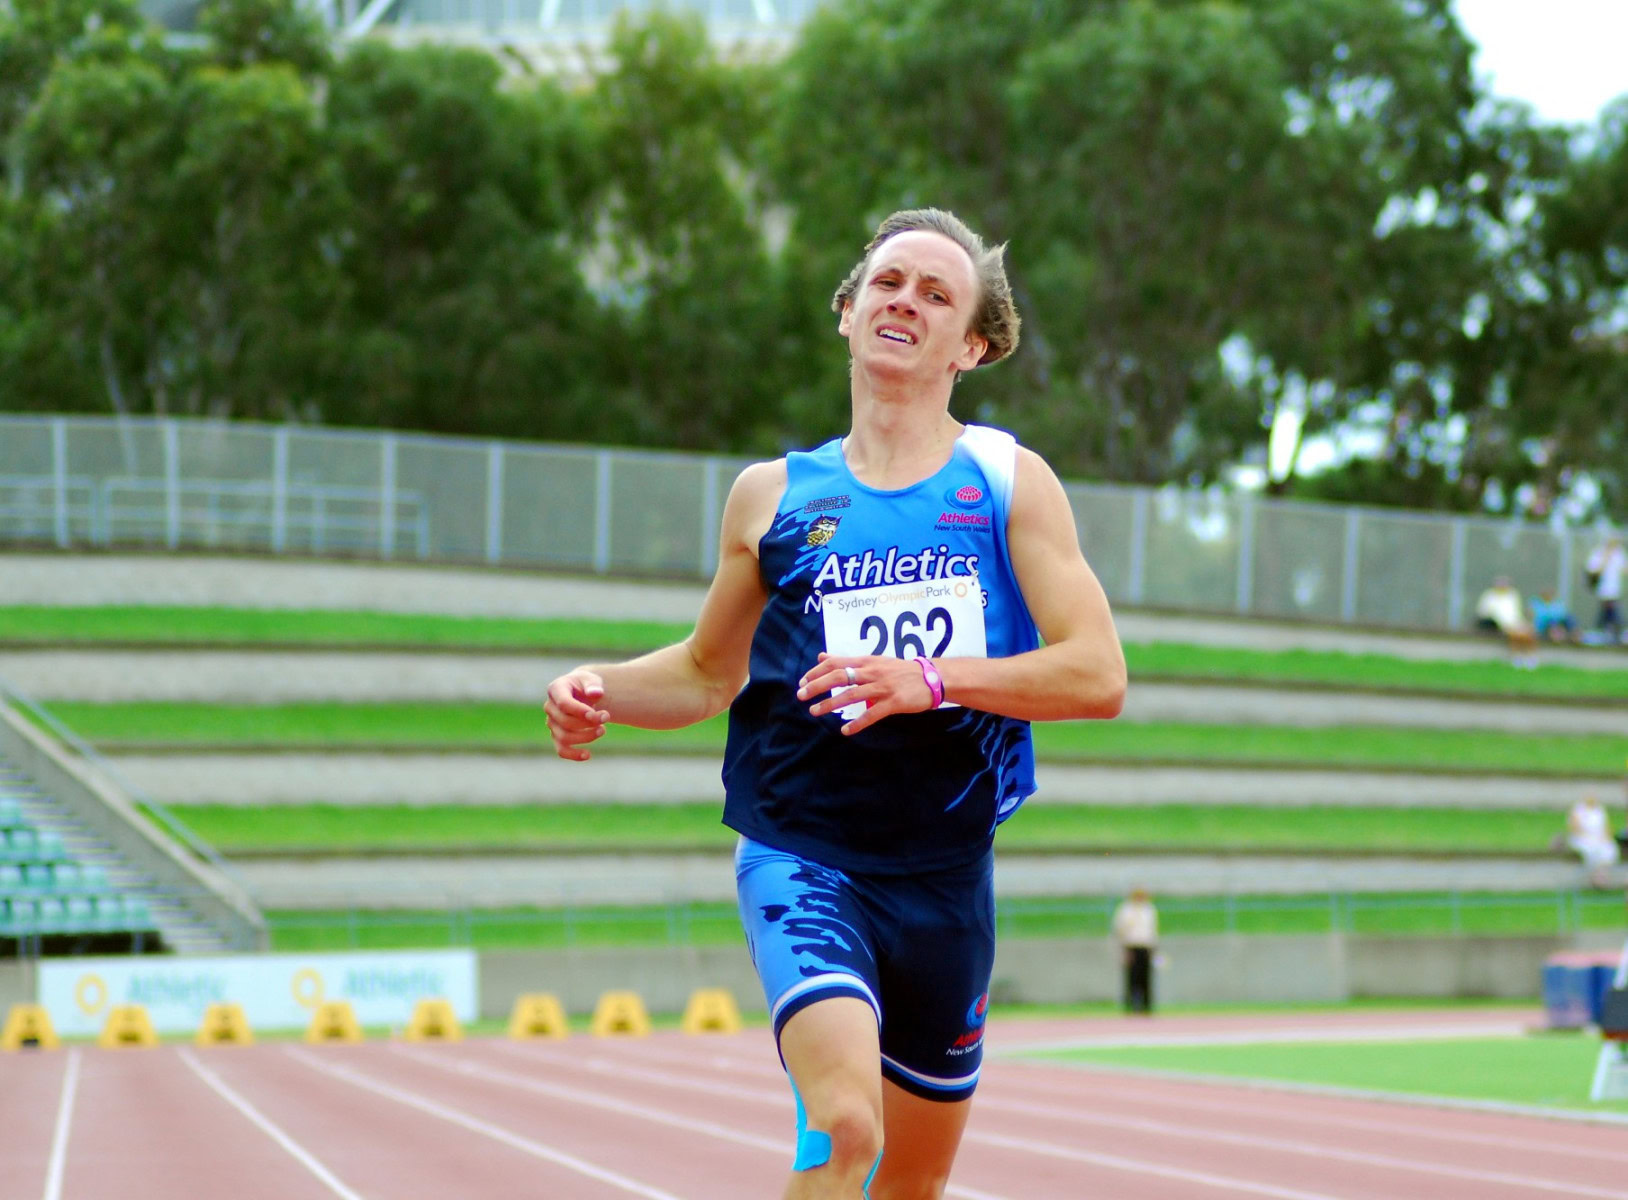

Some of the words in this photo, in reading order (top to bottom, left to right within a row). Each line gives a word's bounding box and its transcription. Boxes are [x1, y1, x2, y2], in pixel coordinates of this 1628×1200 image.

[937, 511, 990, 526] Athletics
[951, 524, 972, 532] South
[812, 544, 980, 588] Athletics
[859, 606, 954, 660] 262
